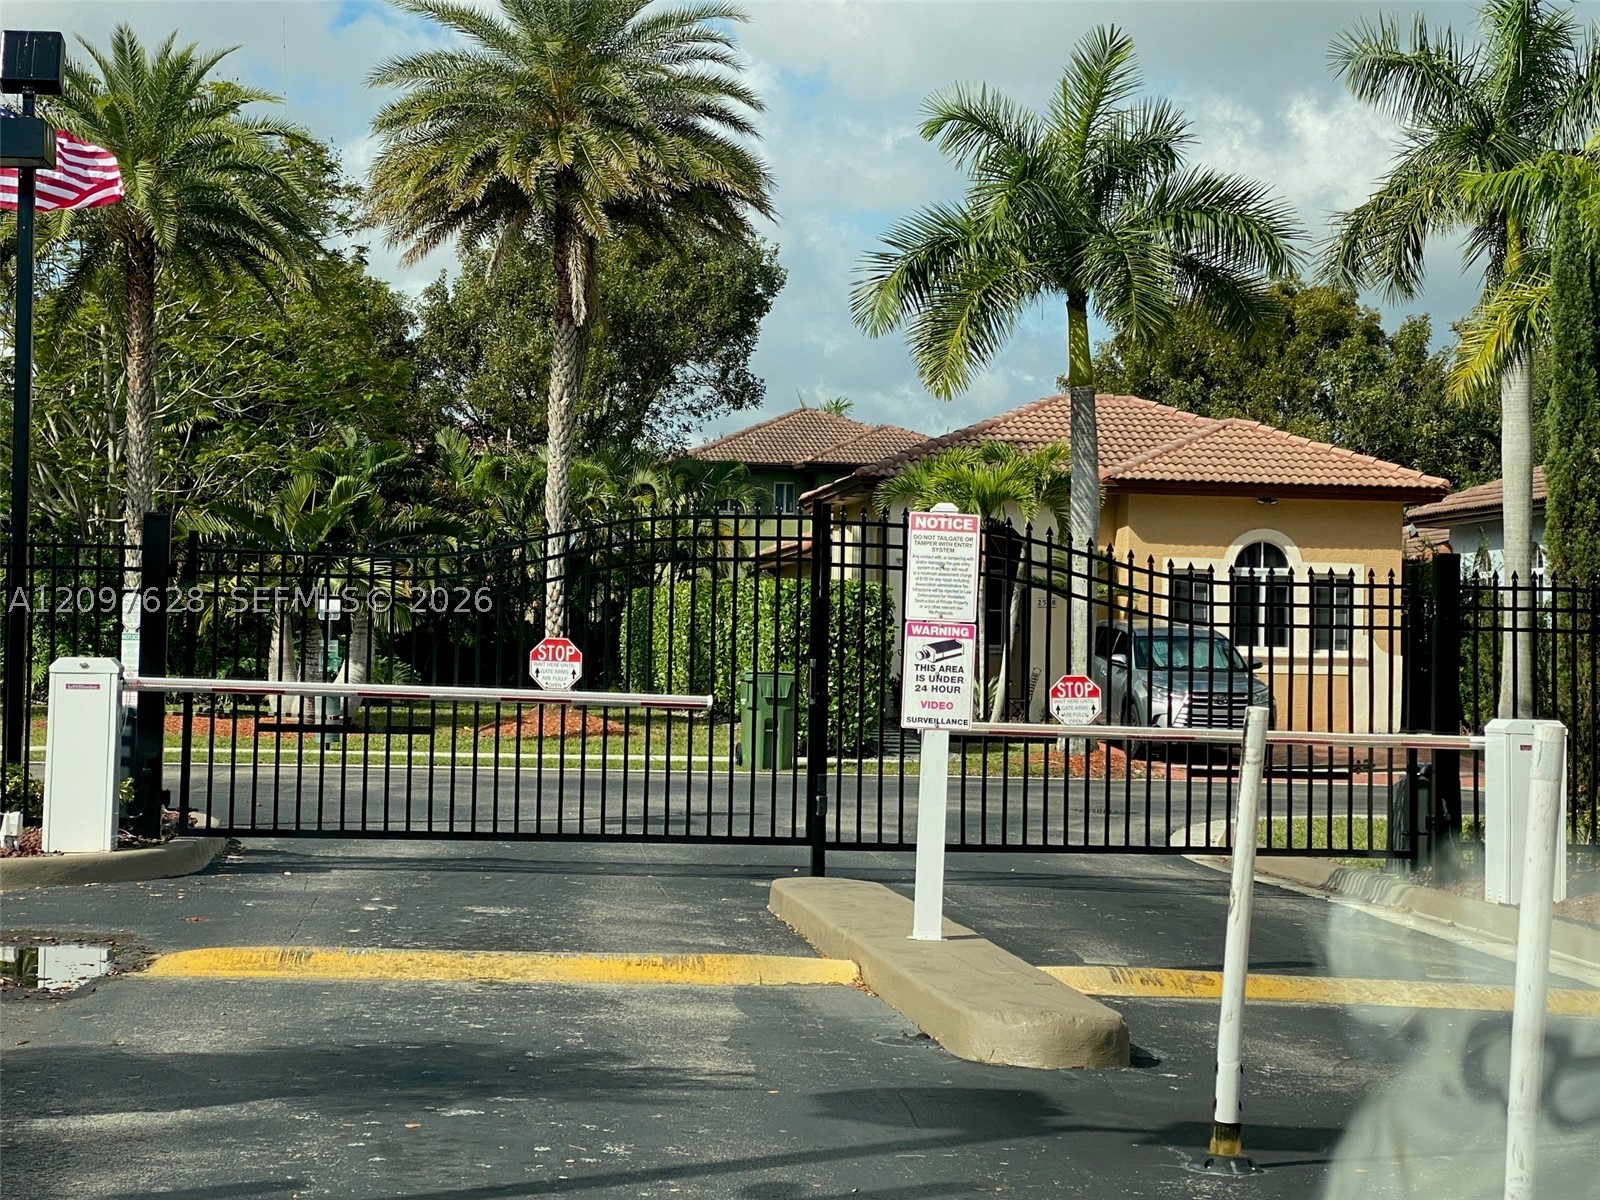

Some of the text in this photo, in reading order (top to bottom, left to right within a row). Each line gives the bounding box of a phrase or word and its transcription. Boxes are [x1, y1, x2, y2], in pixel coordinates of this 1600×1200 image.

[915, 517, 973, 530] NOTICE
[911, 625, 969, 637] WARNING
[538, 645, 575, 661] STOP
[914, 664, 936, 672] THIS
[929, 675, 964, 683] UNDER
[1057, 682, 1093, 697] STOP
[921, 701, 954, 710] VIDEO
[906, 716, 968, 725] SURVEILLANCE
